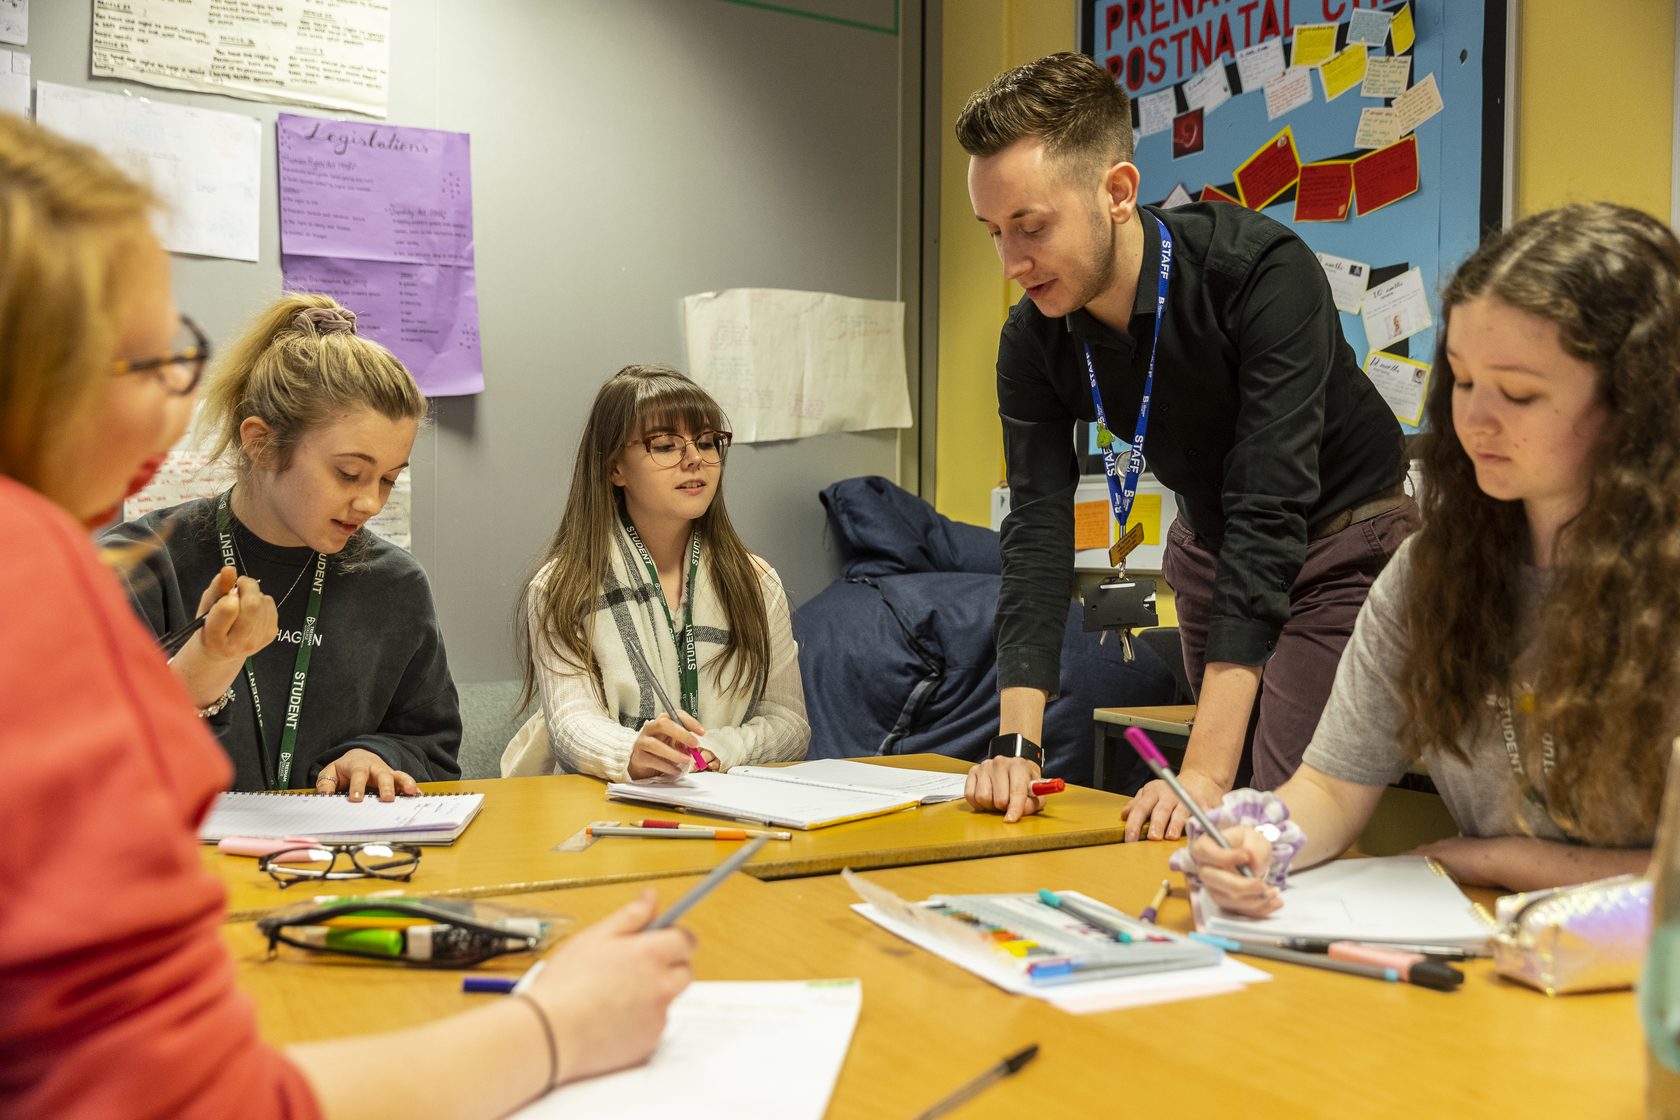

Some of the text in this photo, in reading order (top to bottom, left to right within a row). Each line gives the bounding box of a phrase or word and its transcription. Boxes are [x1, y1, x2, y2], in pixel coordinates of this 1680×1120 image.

[305, 122, 428, 156] Legislations
[1160, 239, 1172, 280] STAFF
[1104, 447, 1117, 477] STAF
[1127, 434, 1144, 474] STAFF
[220, 532, 236, 567] DENT
[626, 525, 653, 567] STUDENT
[312, 552, 327, 595] UDENT
[686, 623, 698, 671] STUDENT
[285, 671, 306, 731] STUDENT
